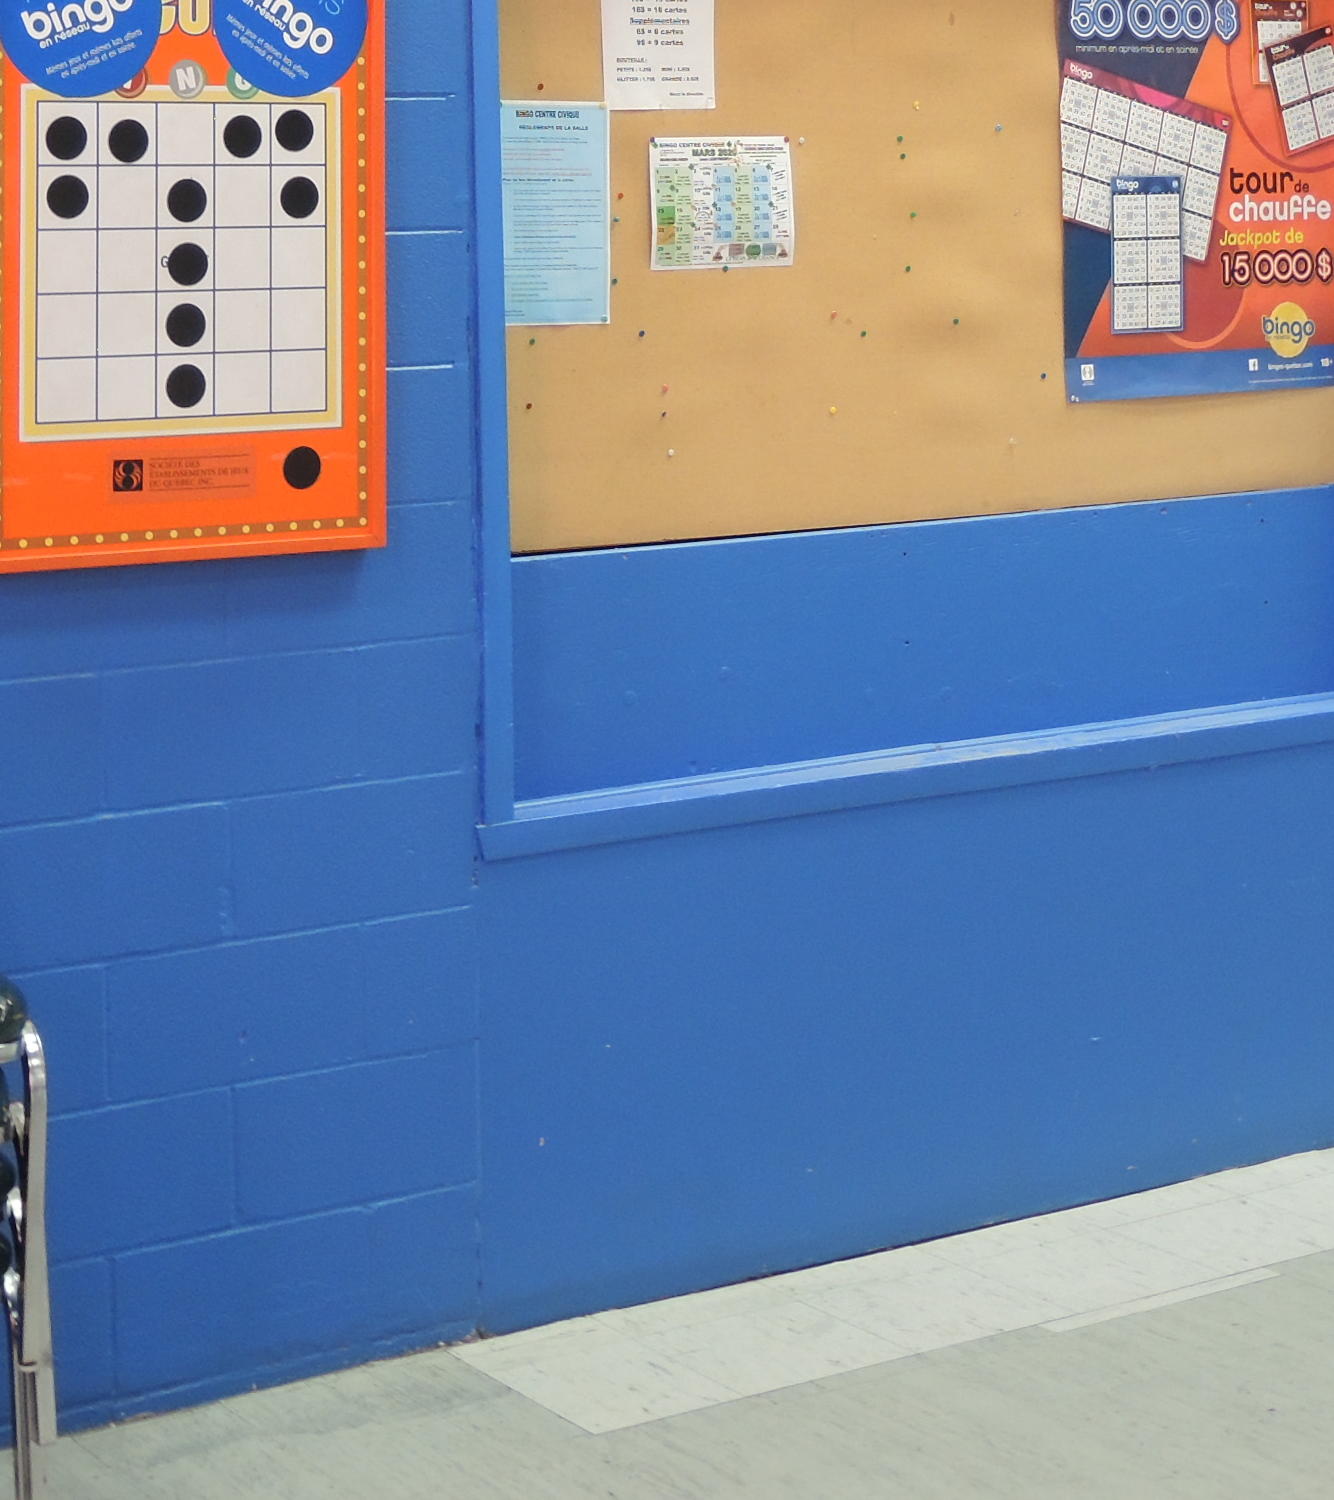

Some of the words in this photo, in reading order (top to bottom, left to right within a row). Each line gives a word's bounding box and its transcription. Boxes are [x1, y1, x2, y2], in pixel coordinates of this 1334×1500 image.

[254, 4, 286, 31] réseau
[40, 38, 53, 48] en
[54, 22, 90, 43] réseau
[175, 66, 197, 91] N
[1070, 63, 1093, 79] bingo
[1230, 168, 1294, 194] tour
[1294, 180, 1309, 193] de
[1229, 194, 1331, 222] chauffe
[1220, 229, 1280, 249] Jackpot
[1285, 228, 1304, 244] de
[1221, 251, 1251, 285] 15
[1253, 250, 1314, 284] 000
[1317, 247, 1333, 282] $
[1262, 315, 1315, 344] bingo
